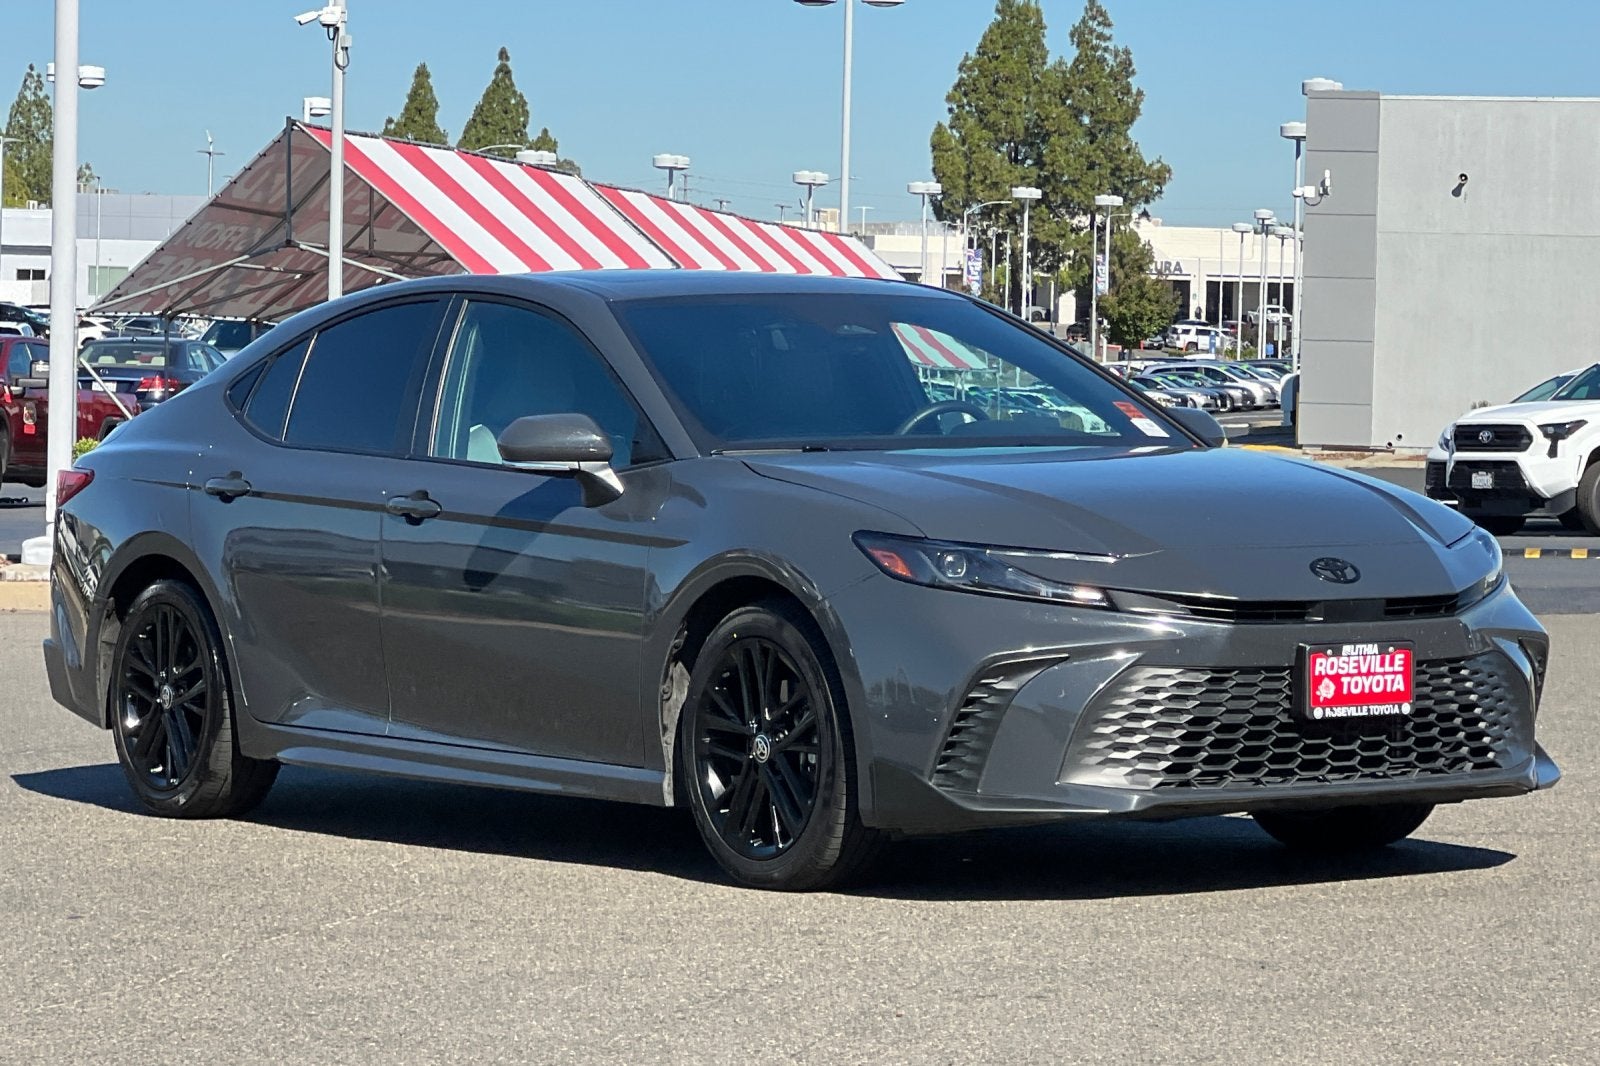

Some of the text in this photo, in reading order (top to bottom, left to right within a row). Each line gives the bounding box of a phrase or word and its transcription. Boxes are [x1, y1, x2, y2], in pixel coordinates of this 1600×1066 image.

[1351, 643, 1379, 655] LITHIA
[1315, 653, 1405, 676] ROSEVILLE
[1340, 674, 1405, 695] TOYOTA
[1368, 704, 1400, 716] TOYOTA
